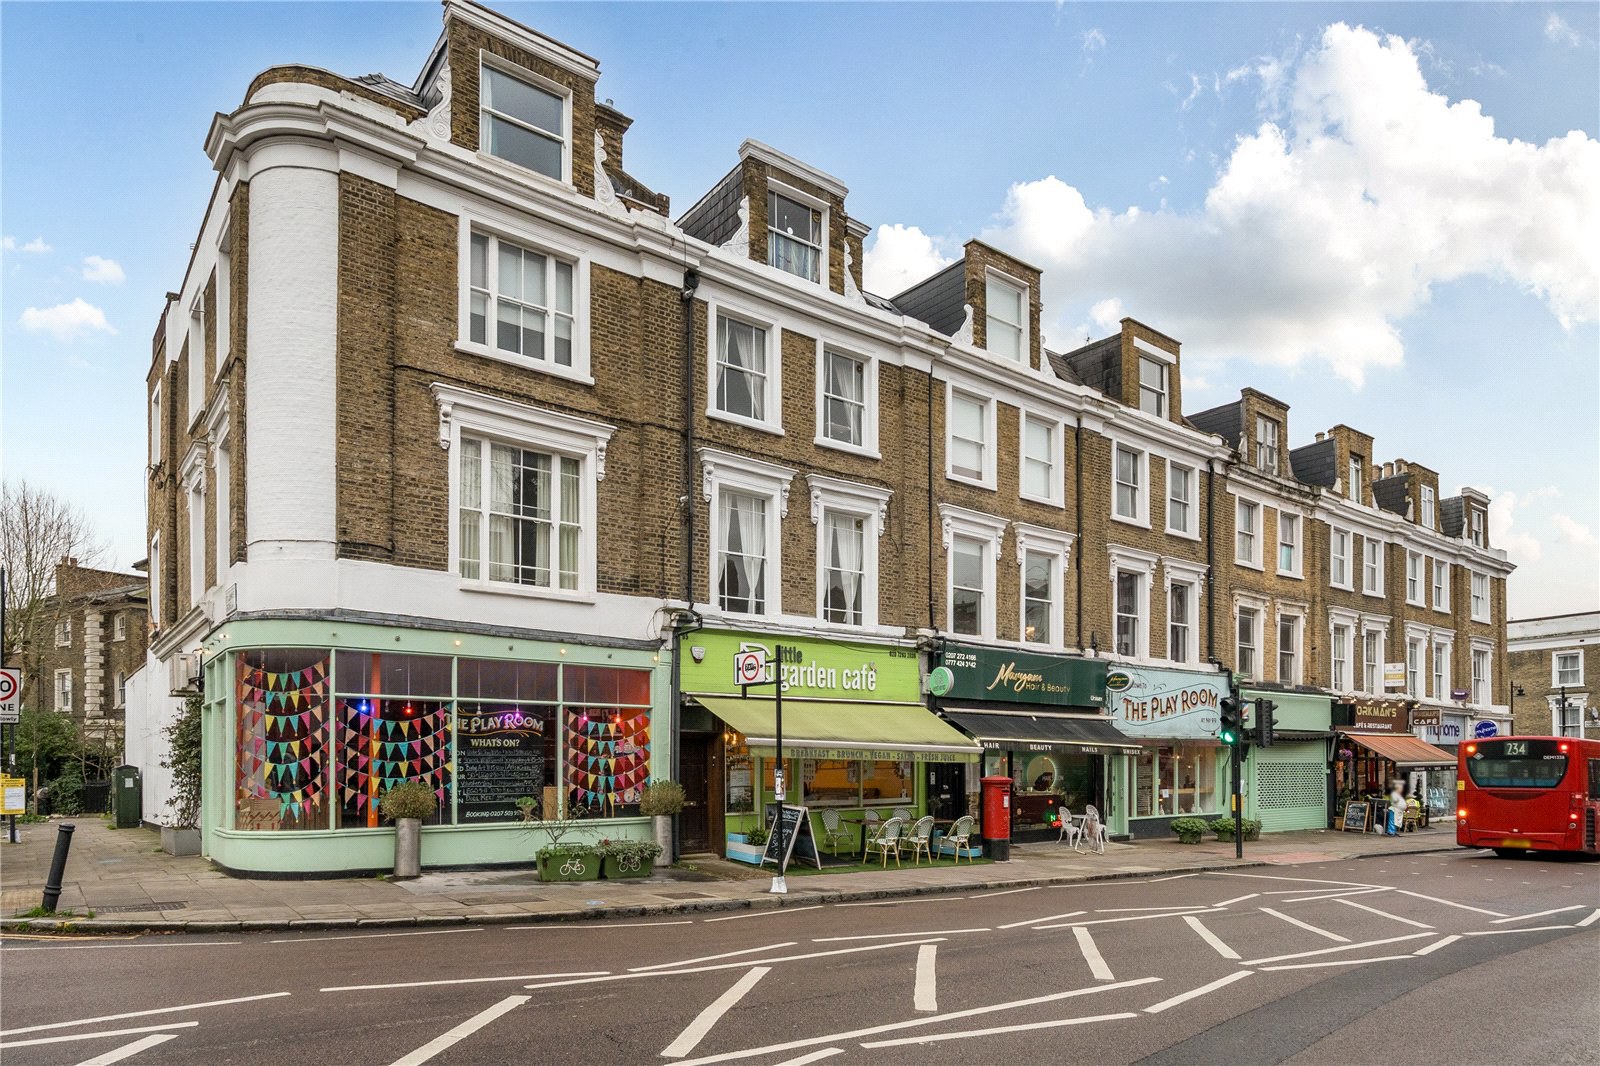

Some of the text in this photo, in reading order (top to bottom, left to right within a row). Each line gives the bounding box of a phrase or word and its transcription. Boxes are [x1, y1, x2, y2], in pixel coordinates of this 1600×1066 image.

[780, 646, 803, 664] ittle
[781, 660, 836, 692] garden
[0, 680, 12, 693] 0
[1025, 682, 1040, 691] Hair
[0, 703, 15, 711] NE
[1123, 689, 1218, 721] THE PLAY ROOM
[1356, 705, 1397, 718] ORKMAN'S
[469, 716, 503, 733] PLAY
[503, 713, 544, 731] ROOM
[470, 738, 520, 747] WHAT'S ON?
[1029, 743, 1052, 751] BEAUTY
[1506, 742, 1526, 756] 234
[790, 748, 830, 758] BREAKFAST
[836, 750, 864, 759] BRUNCH
[870, 751, 891, 760] VEGAN
[921, 753, 939, 761] FRESH
